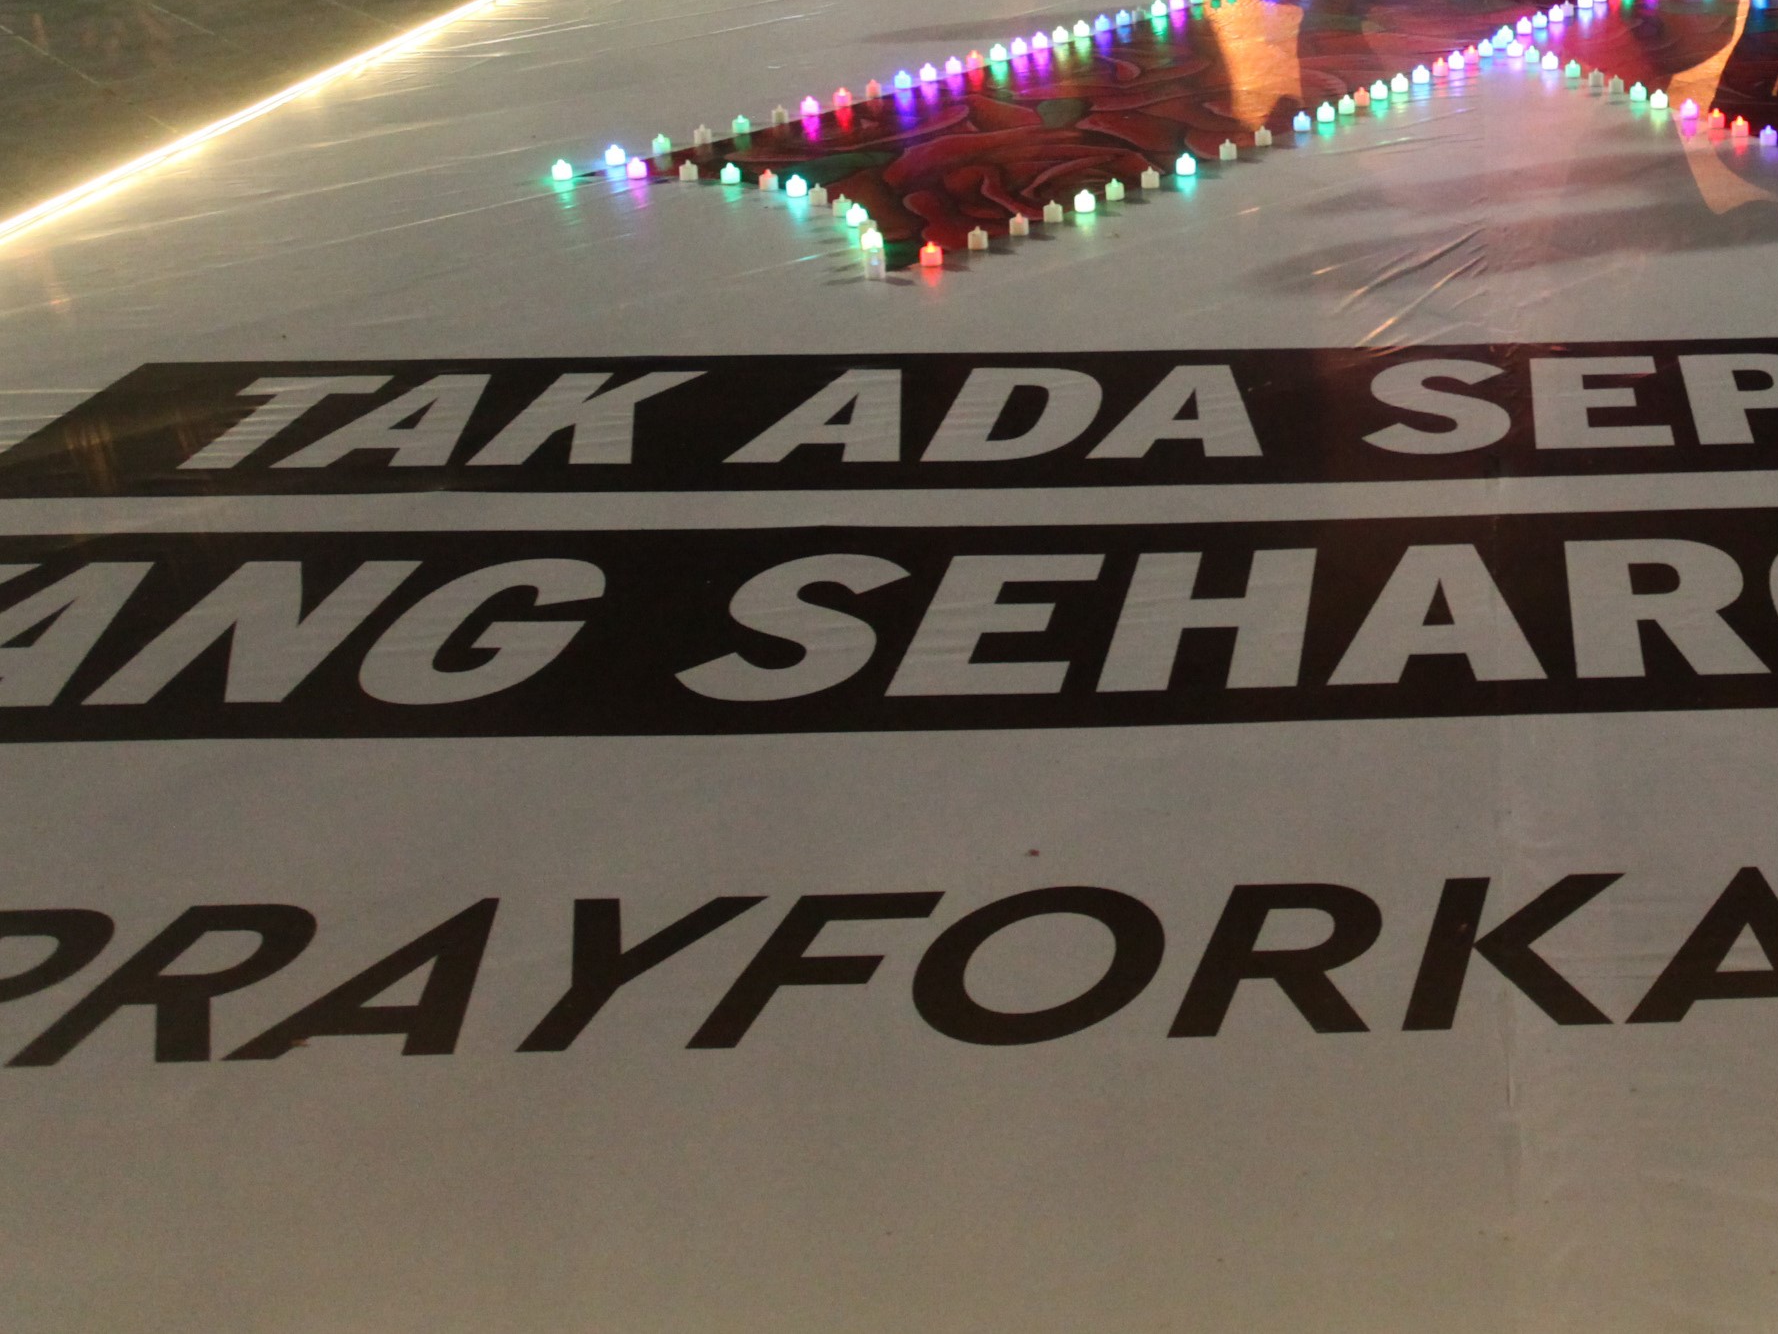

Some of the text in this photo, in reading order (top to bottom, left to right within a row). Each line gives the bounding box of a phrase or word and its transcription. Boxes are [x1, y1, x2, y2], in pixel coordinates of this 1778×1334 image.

[176, 369, 710, 469] TAK
[722, 364, 1264, 463] ADA
[0, 558, 608, 708] ANG
